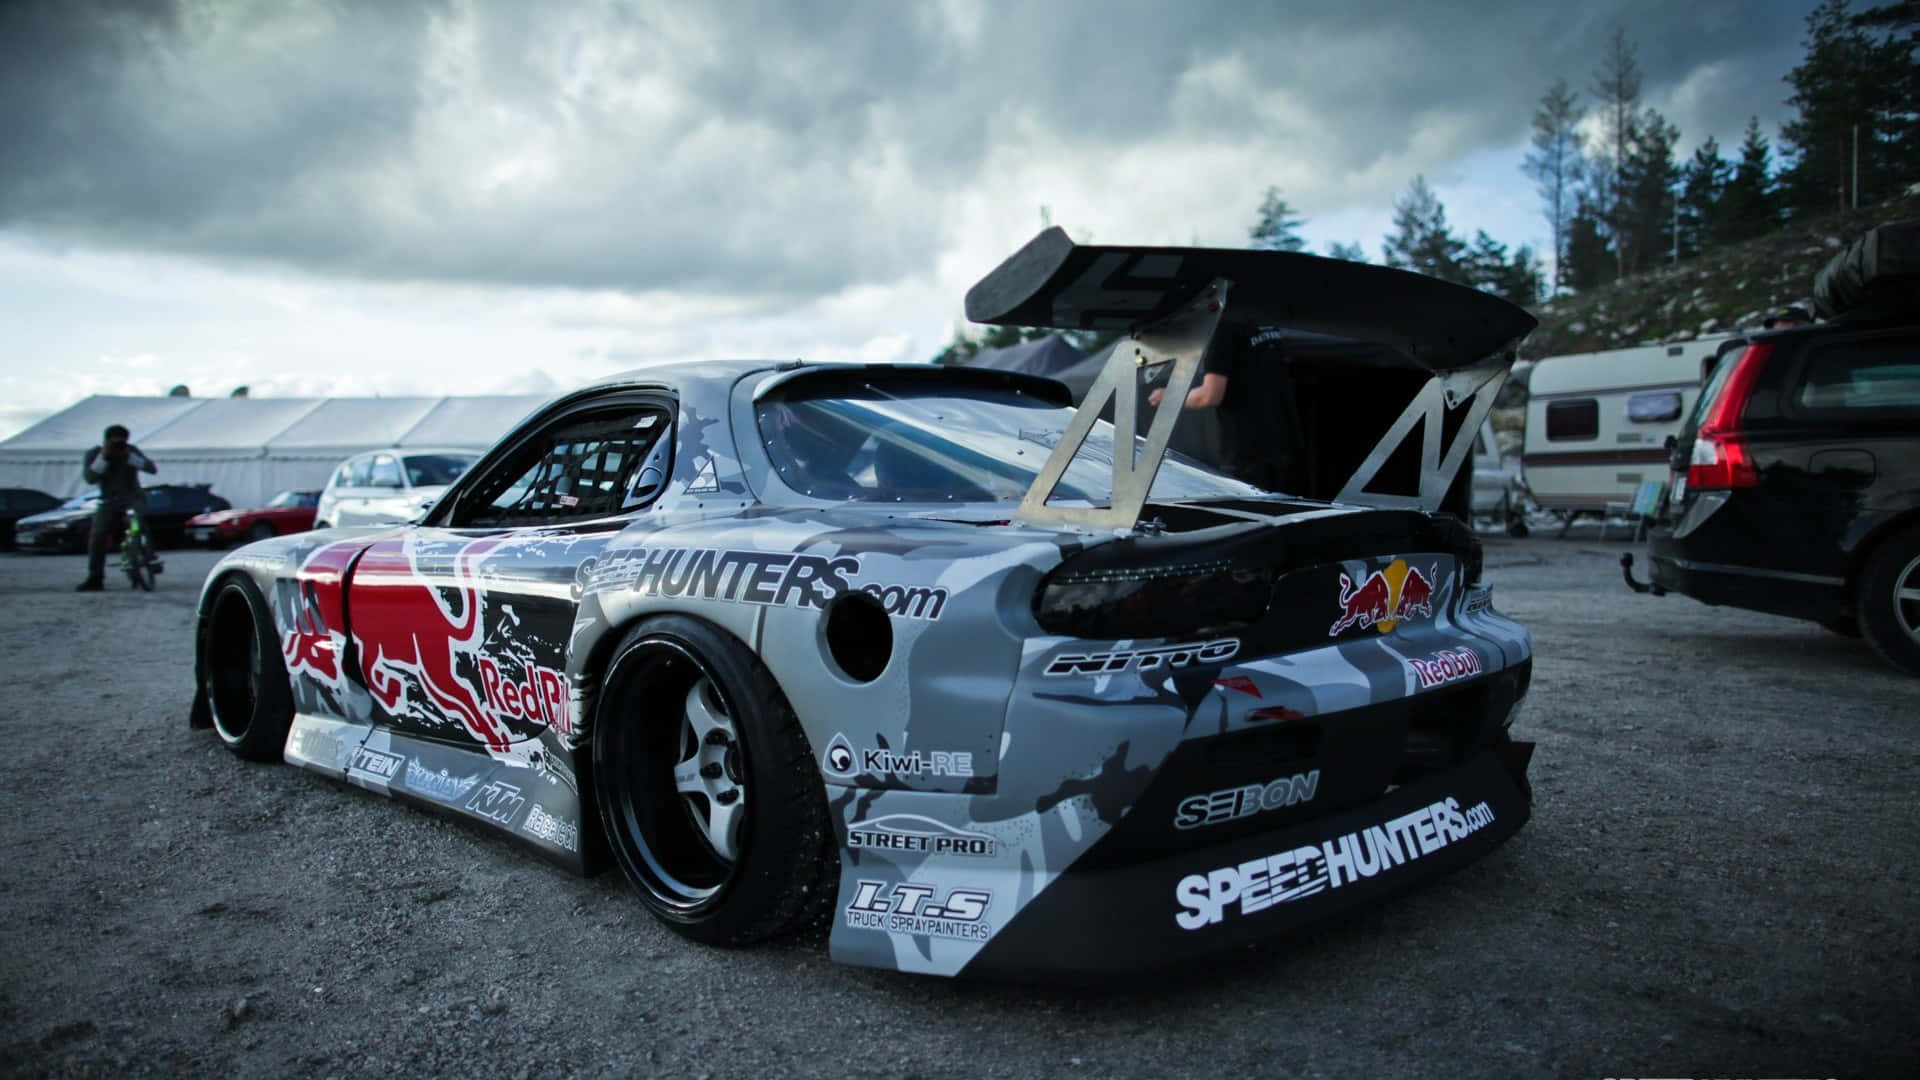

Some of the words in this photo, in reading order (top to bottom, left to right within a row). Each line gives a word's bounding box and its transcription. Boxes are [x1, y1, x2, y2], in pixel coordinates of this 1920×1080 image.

[570, 548, 948, 620] SEEDHUNTERScom
[1043, 637, 1241, 676] NITTO
[1407, 651, 1457, 688] Red
[478, 657, 547, 726] Red
[535, 666, 574, 735] Bll
[360, 750, 402, 776] TEIN
[863, 748, 974, 777] Kiwi-RE
[465, 780, 526, 825] KTM
[1174, 770, 1320, 829] SEIBON
[848, 830, 930, 851] STREET
[935, 837, 987, 855] PRO
[1175, 797, 1496, 931] SPEEDHUNTERS.com
[847, 880, 992, 922] I.T.S
[847, 910, 886, 929] TRUCK
[889, 916, 990, 941] SPRAYPAINTERS
